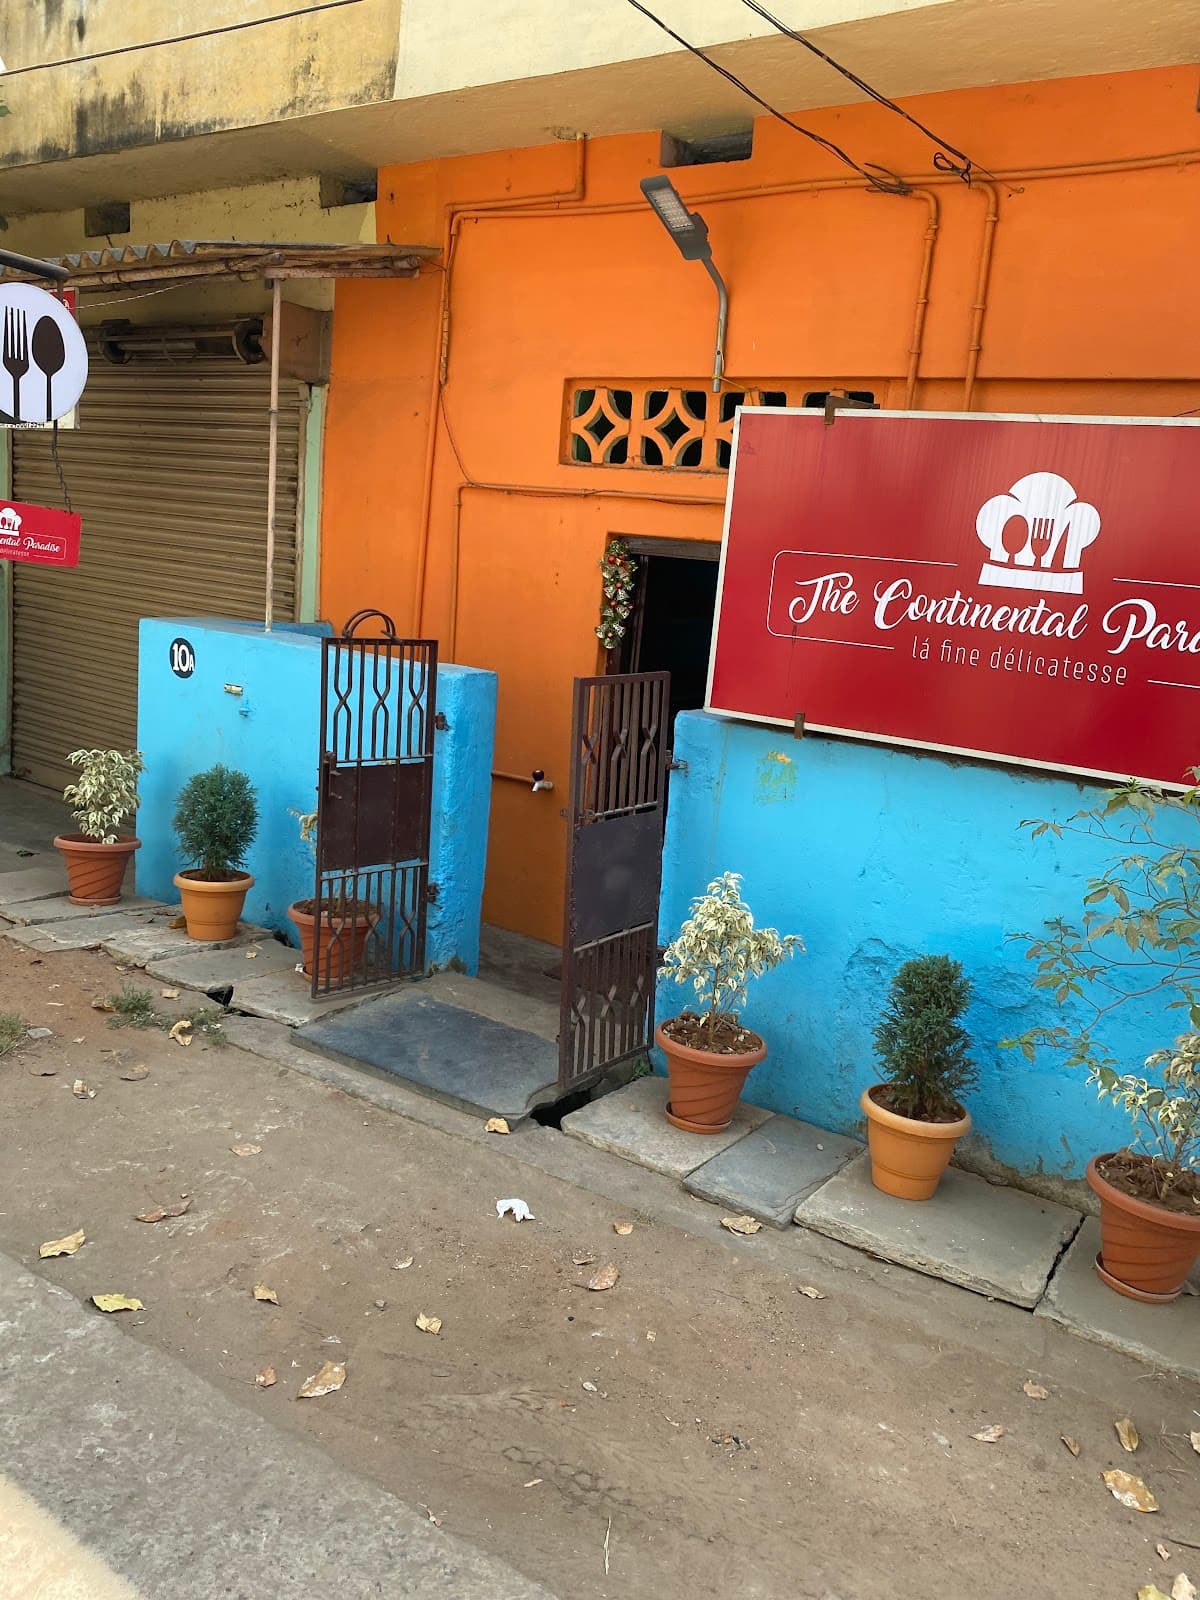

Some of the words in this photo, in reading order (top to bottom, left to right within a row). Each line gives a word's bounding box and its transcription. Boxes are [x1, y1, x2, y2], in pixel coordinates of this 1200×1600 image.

[23, 536, 61, 552] Paradise
[788, 571, 860, 624] The
[873, 578, 1089, 640] Continental
[171, 642, 195, 673] 10A
[940, 639, 981, 667] fine
[989, 646, 1127, 686] délicatesse
